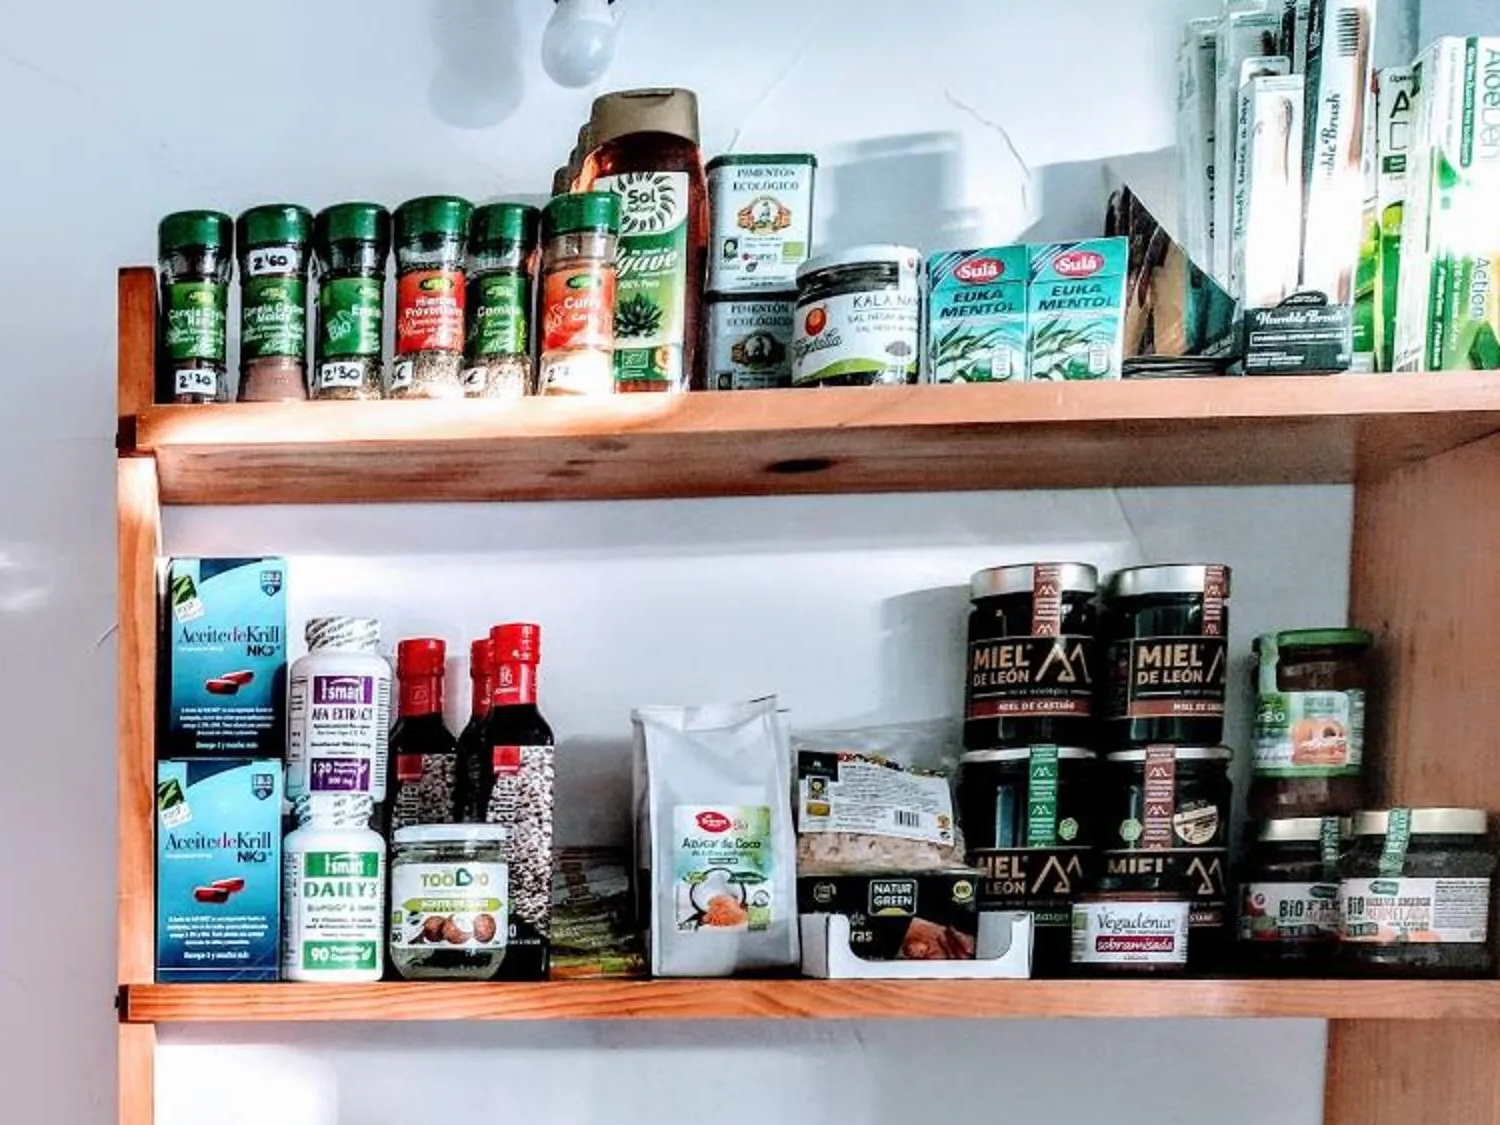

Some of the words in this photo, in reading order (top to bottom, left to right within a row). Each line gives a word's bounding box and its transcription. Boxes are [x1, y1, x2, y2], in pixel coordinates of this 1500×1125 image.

[627, 190, 656, 205] Sol
[253, 254, 288, 271] 2'60
[1470, 257, 1491, 320] Action
[940, 303, 1015, 318] MENTOL
[1038, 296, 1114, 311] MENTOL
[973, 645, 1031, 669] MIEL
[1137, 645, 1204, 668] MIEL
[973, 673, 988, 687] DE
[990, 669, 1030, 685] LEÓN
[1137, 672, 1159, 686] DE
[1162, 667, 1203, 684] LEÓN
[735, 836, 761, 850] Coco
[873, 883, 913, 895] NATUR
[873, 895, 913, 906] GREEN
